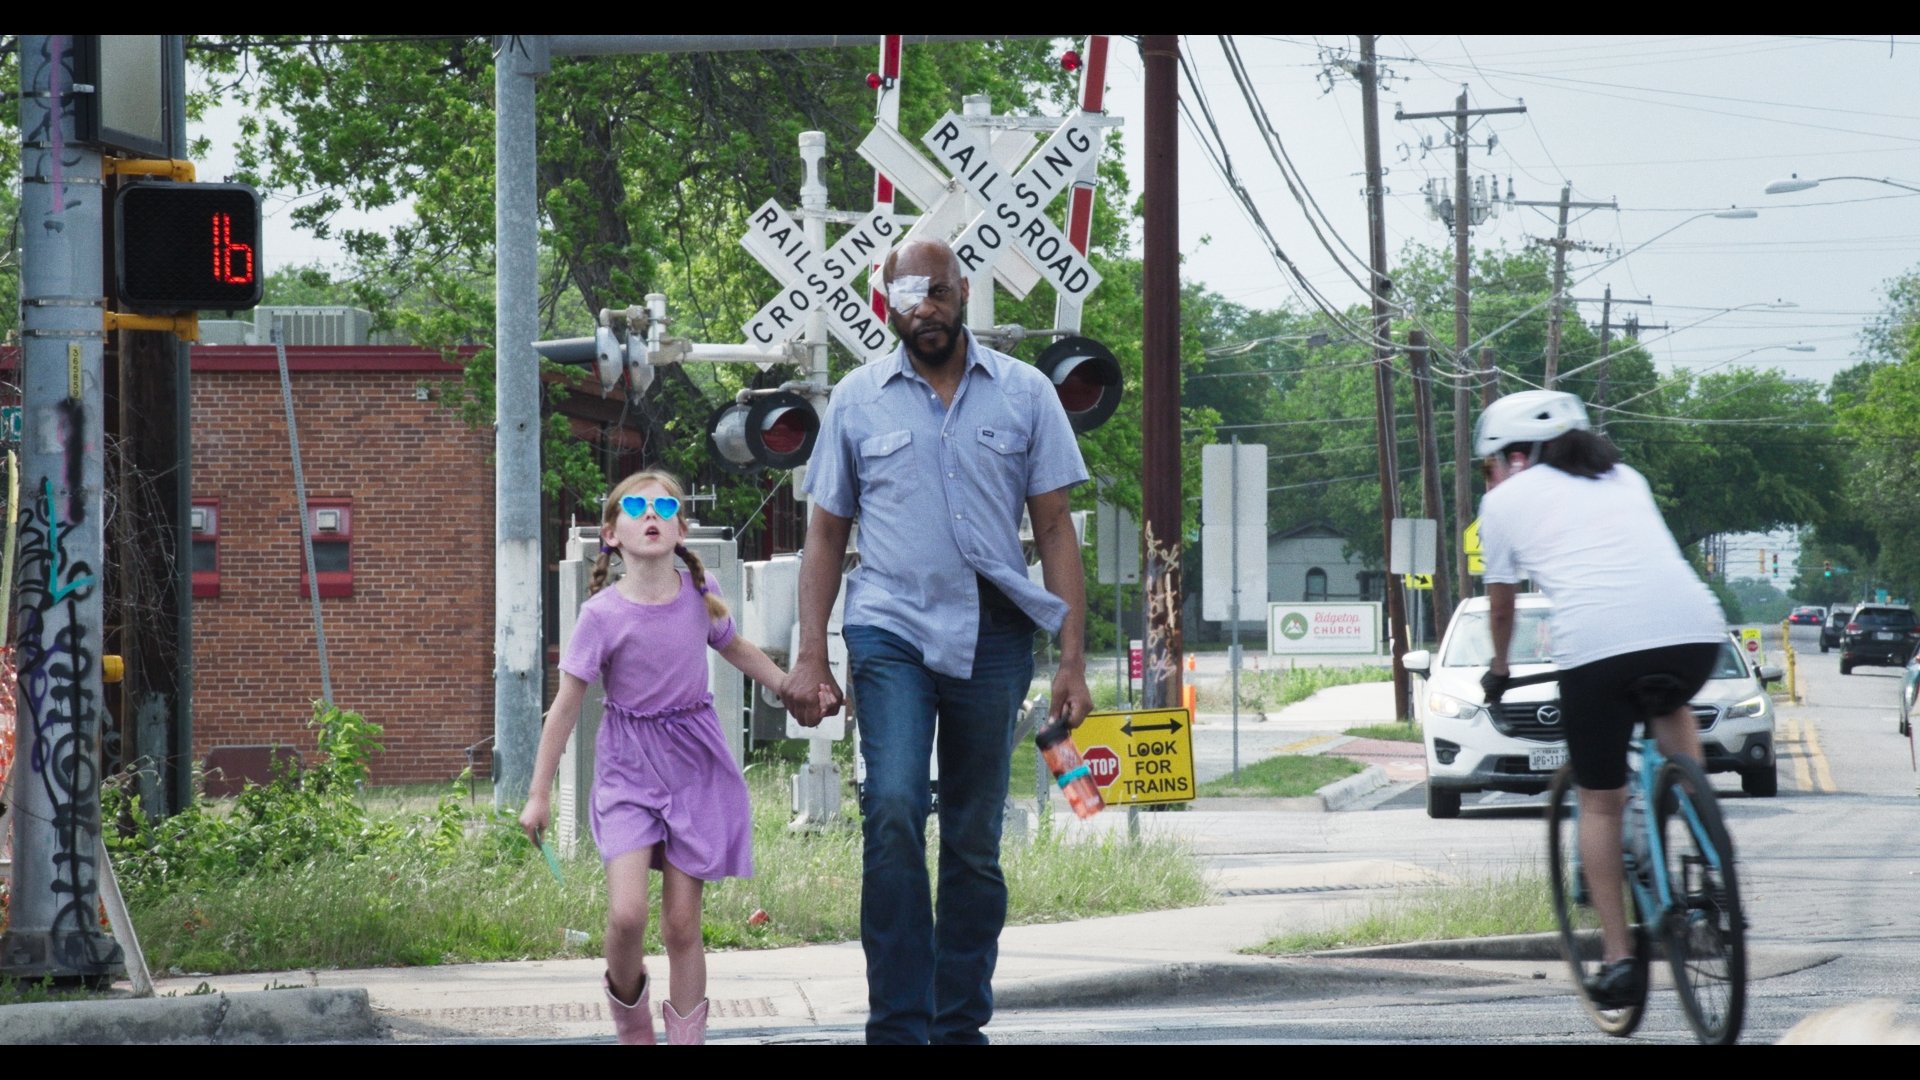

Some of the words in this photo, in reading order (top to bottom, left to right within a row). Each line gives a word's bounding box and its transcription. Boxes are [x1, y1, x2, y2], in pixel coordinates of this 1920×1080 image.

[932, 120, 999, 202] RAIL
[1019, 217, 1090, 294] ROAD
[956, 127, 1091, 272] ROSSING
[212, 212, 253, 283] 16
[752, 215, 893, 344] CROSSING
[755, 206, 812, 274] RAIL
[826, 286, 886, 351] ROAD
[1313, 626, 1361, 635] CHURCH
[1127, 740, 1178, 758] LOOK
[1135, 759, 1172, 776] FOR
[1123, 777, 1189, 795] TRAINS
